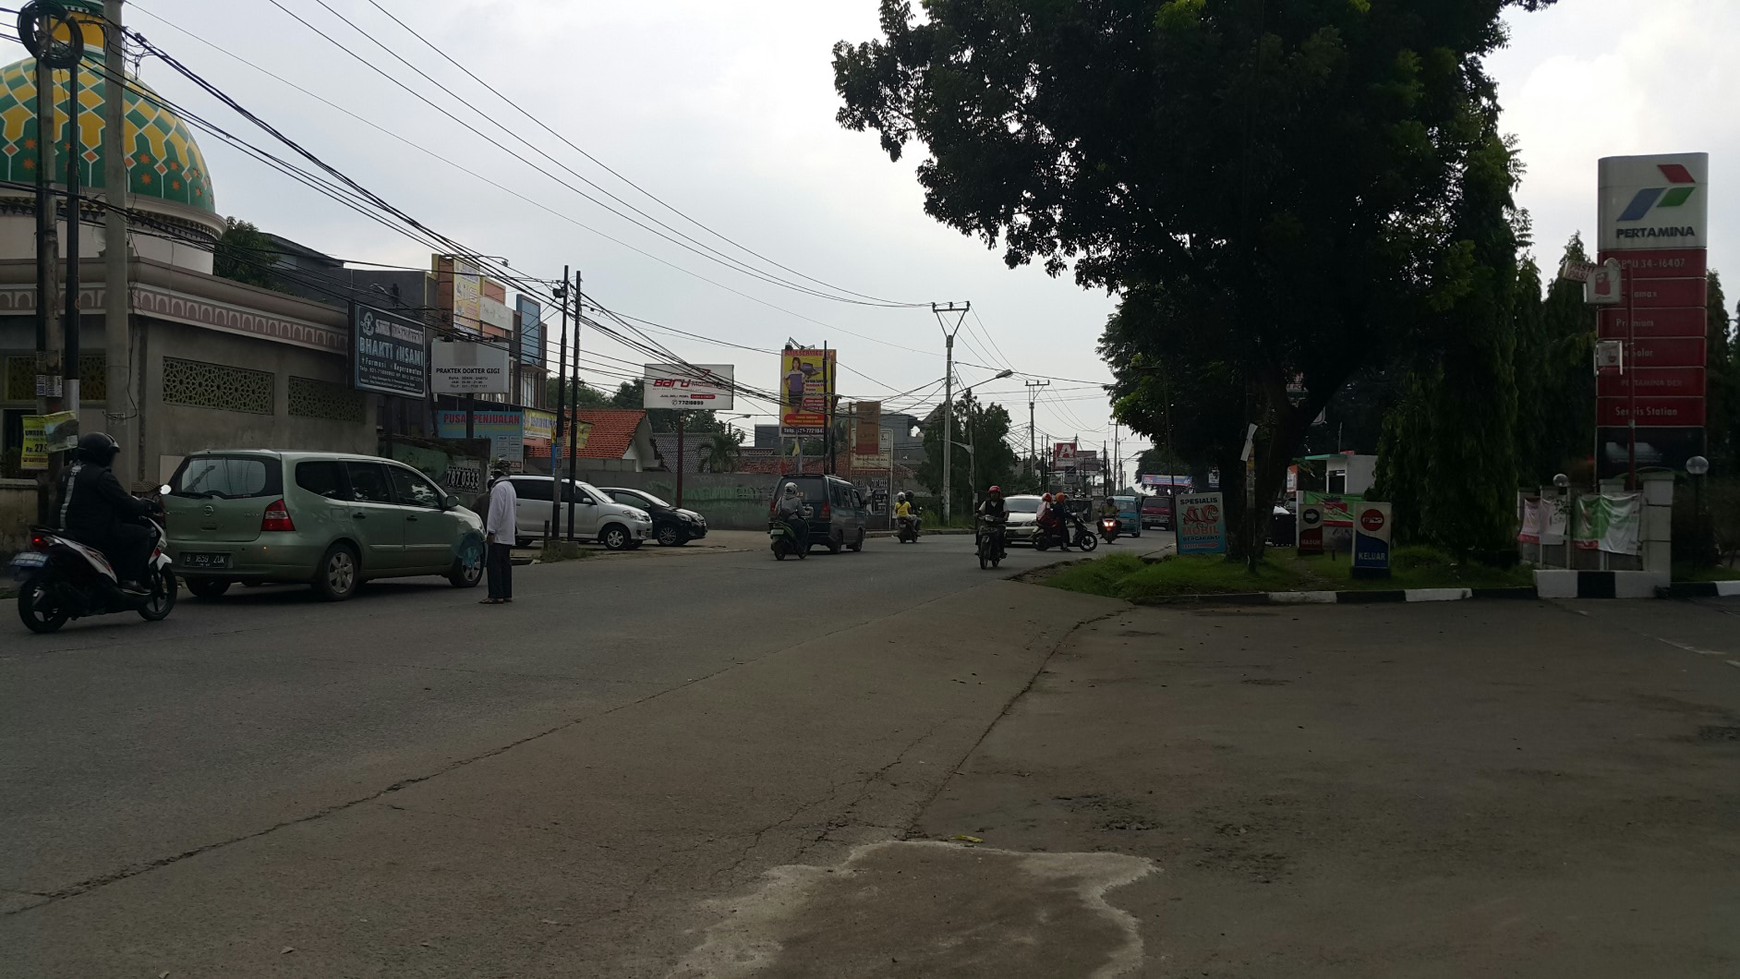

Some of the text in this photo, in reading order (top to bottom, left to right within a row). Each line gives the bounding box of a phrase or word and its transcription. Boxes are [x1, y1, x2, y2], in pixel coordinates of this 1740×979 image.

[1616, 226, 1695, 239] PERTAMINA
[359, 336, 393, 360] BHAKTI
[1646, 406, 1678, 416] Station
[473, 415, 520, 425] PENJUALAN
[1180, 497, 1218, 505] SPESIALIS
[1358, 552, 1386, 560] KELUAR
